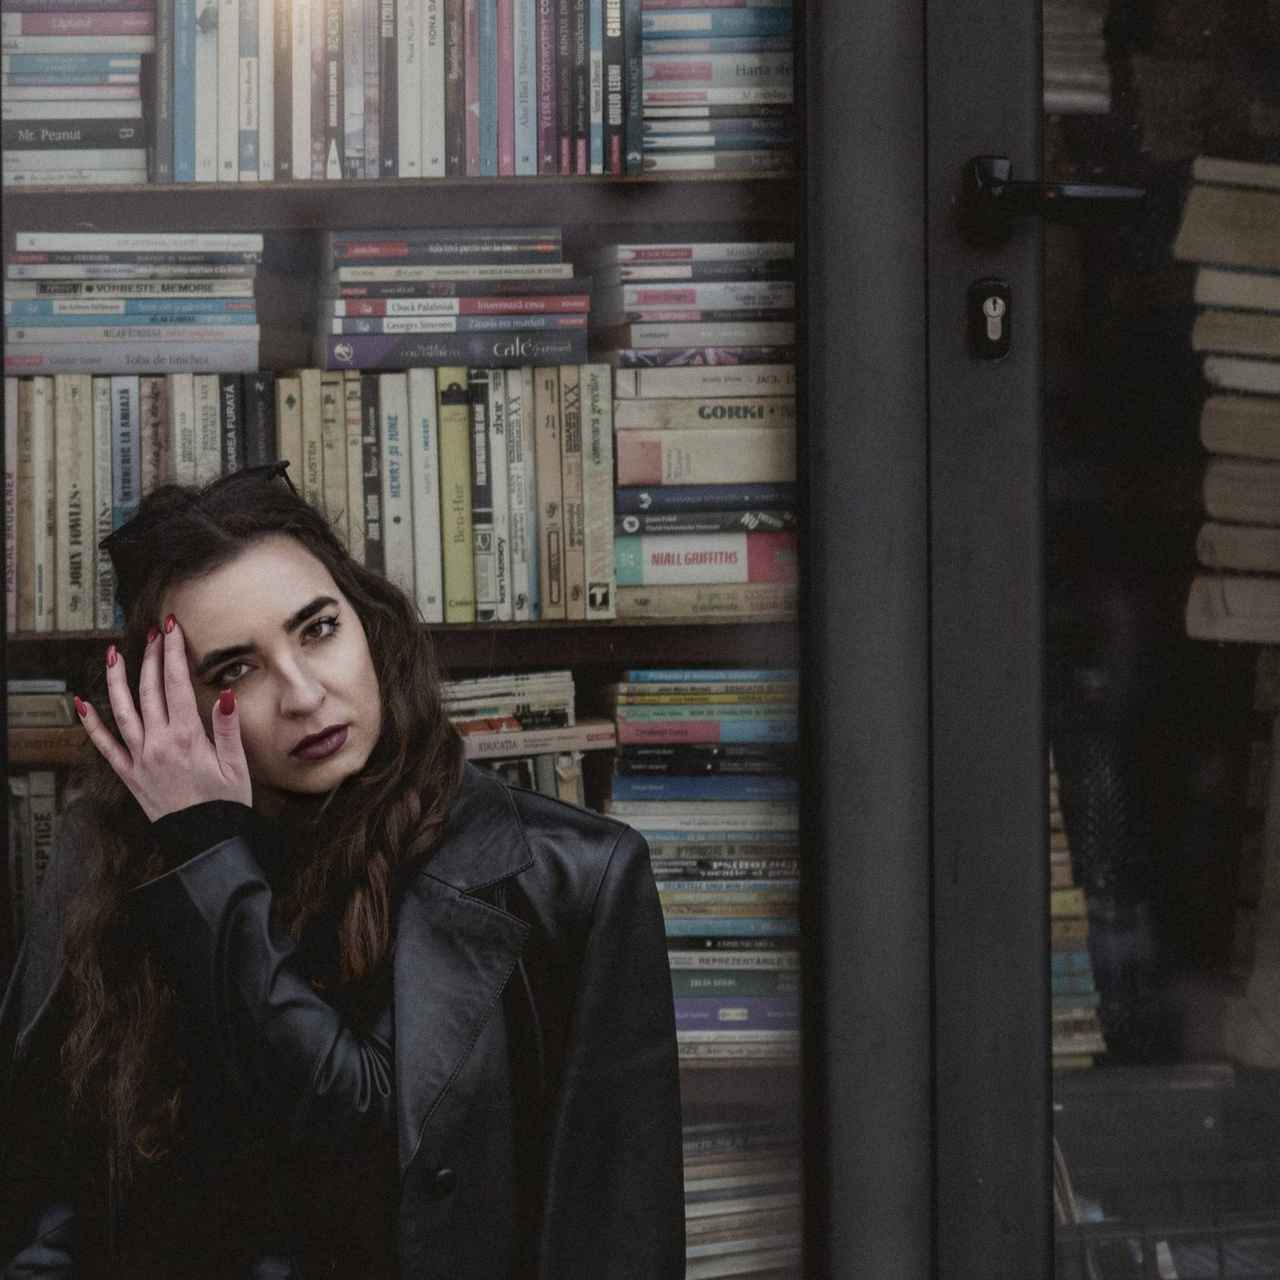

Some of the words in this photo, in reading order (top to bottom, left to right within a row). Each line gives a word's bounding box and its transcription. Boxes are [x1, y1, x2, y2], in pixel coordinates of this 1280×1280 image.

[541, 19, 551, 91] GOLDSWORTHY
[608, 65, 621, 91] LEONI
[543, 96, 552, 128] VESNA
[609, 94, 621, 125] GIULIO
[18, 128, 36, 141] Mr.
[41, 128, 81, 141] Peanut
[392, 302, 416, 312] Chuck
[417, 301, 454, 312] Palahniuk
[387, 321, 418, 332] Georges
[420, 320, 453, 329] Simenon
[493, 401, 504, 435] zbor
[697, 404, 764, 420] GORKI
[308, 441, 317, 484] AUSTEN
[6, 472, 14, 539] BRUCKNER
[68, 490, 82, 546] FOWLES
[453, 484, 466, 543] Ben-Hur
[6, 546, 14, 593] PASCAL
[652, 552, 682, 566] NIALL
